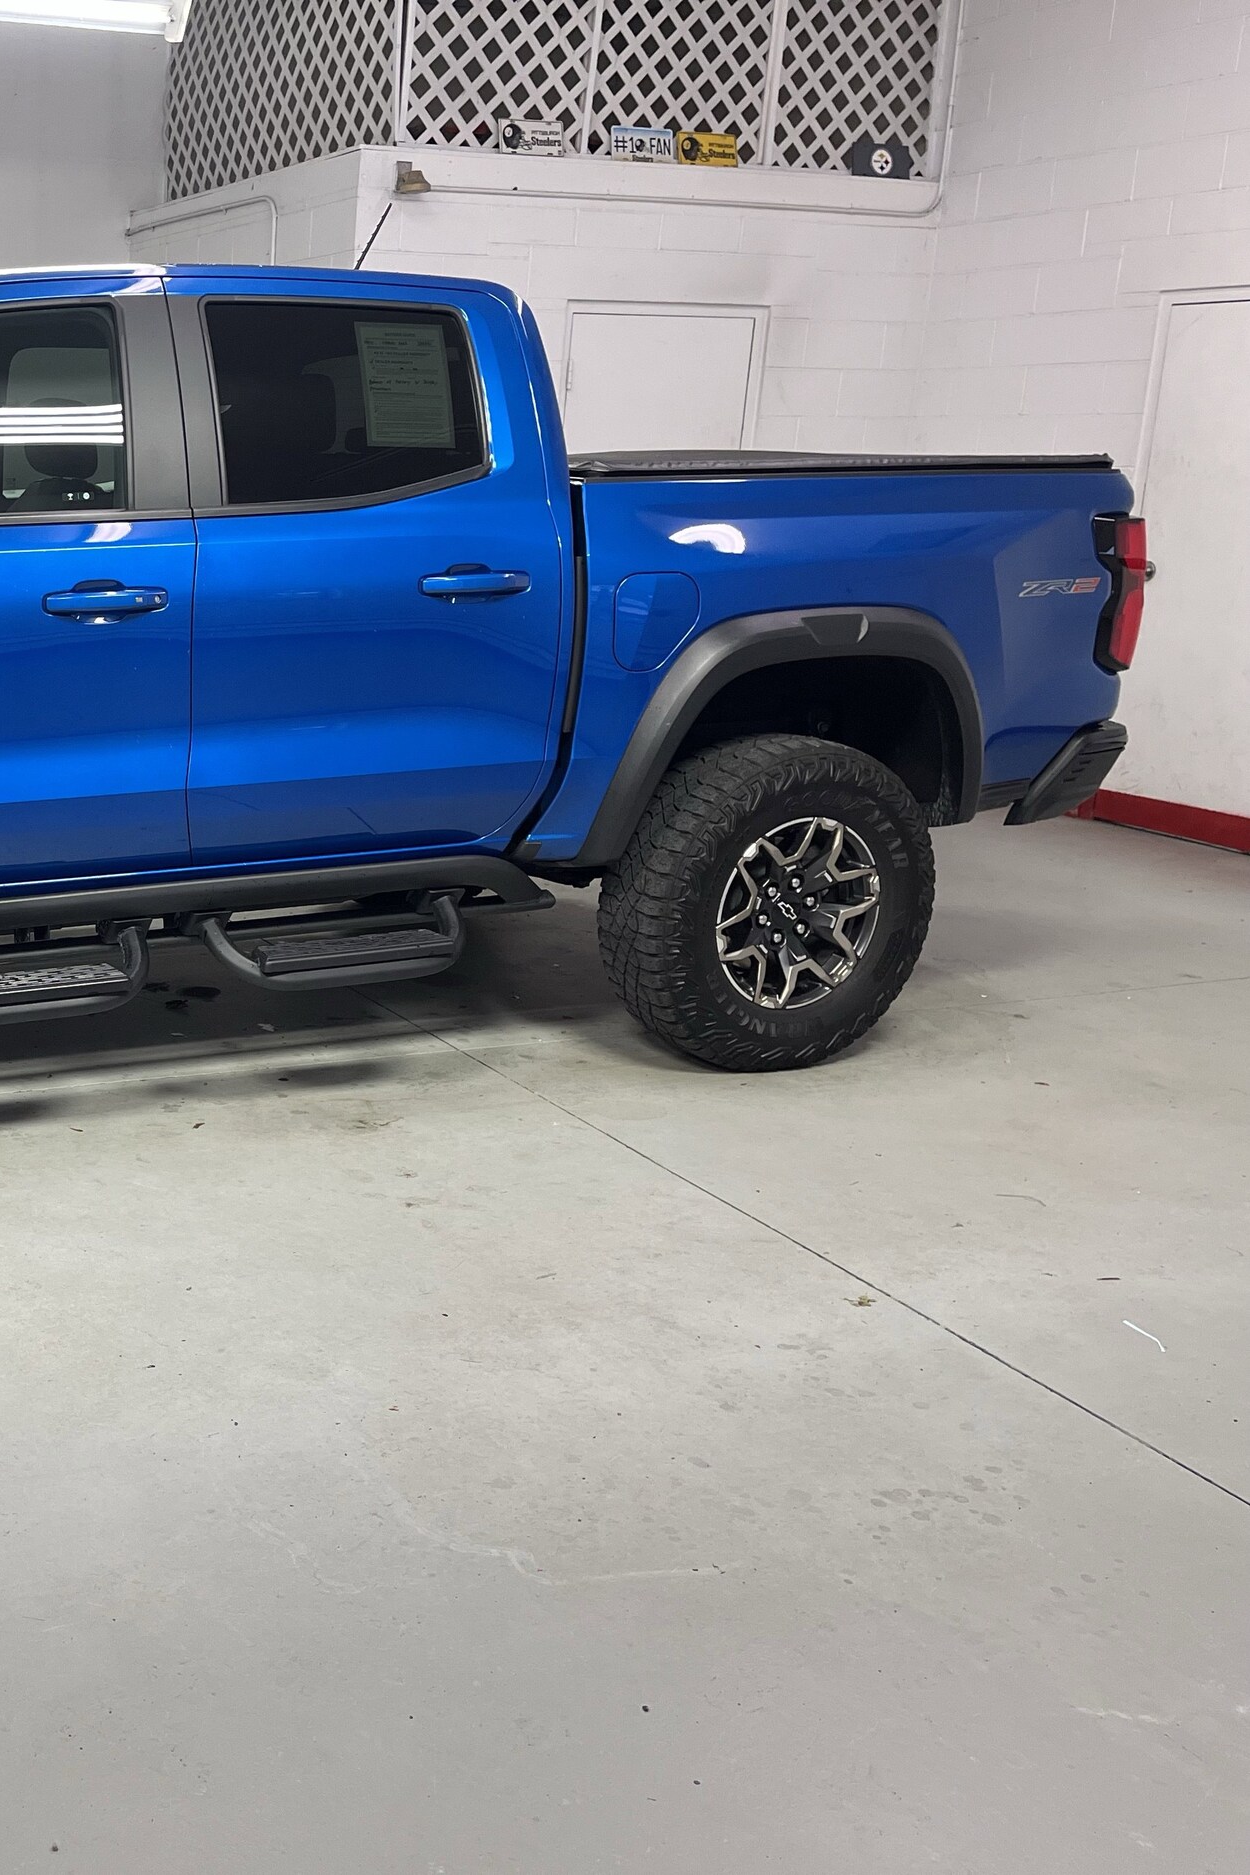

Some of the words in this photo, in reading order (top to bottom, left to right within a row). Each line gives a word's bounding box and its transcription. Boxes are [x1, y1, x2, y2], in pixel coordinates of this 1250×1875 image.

[531, 136, 562, 147] Steelers
[649, 137, 671, 155] FAN
[708, 149, 735, 159] Steelers
[1018, 577, 1101, 598] ZR2
